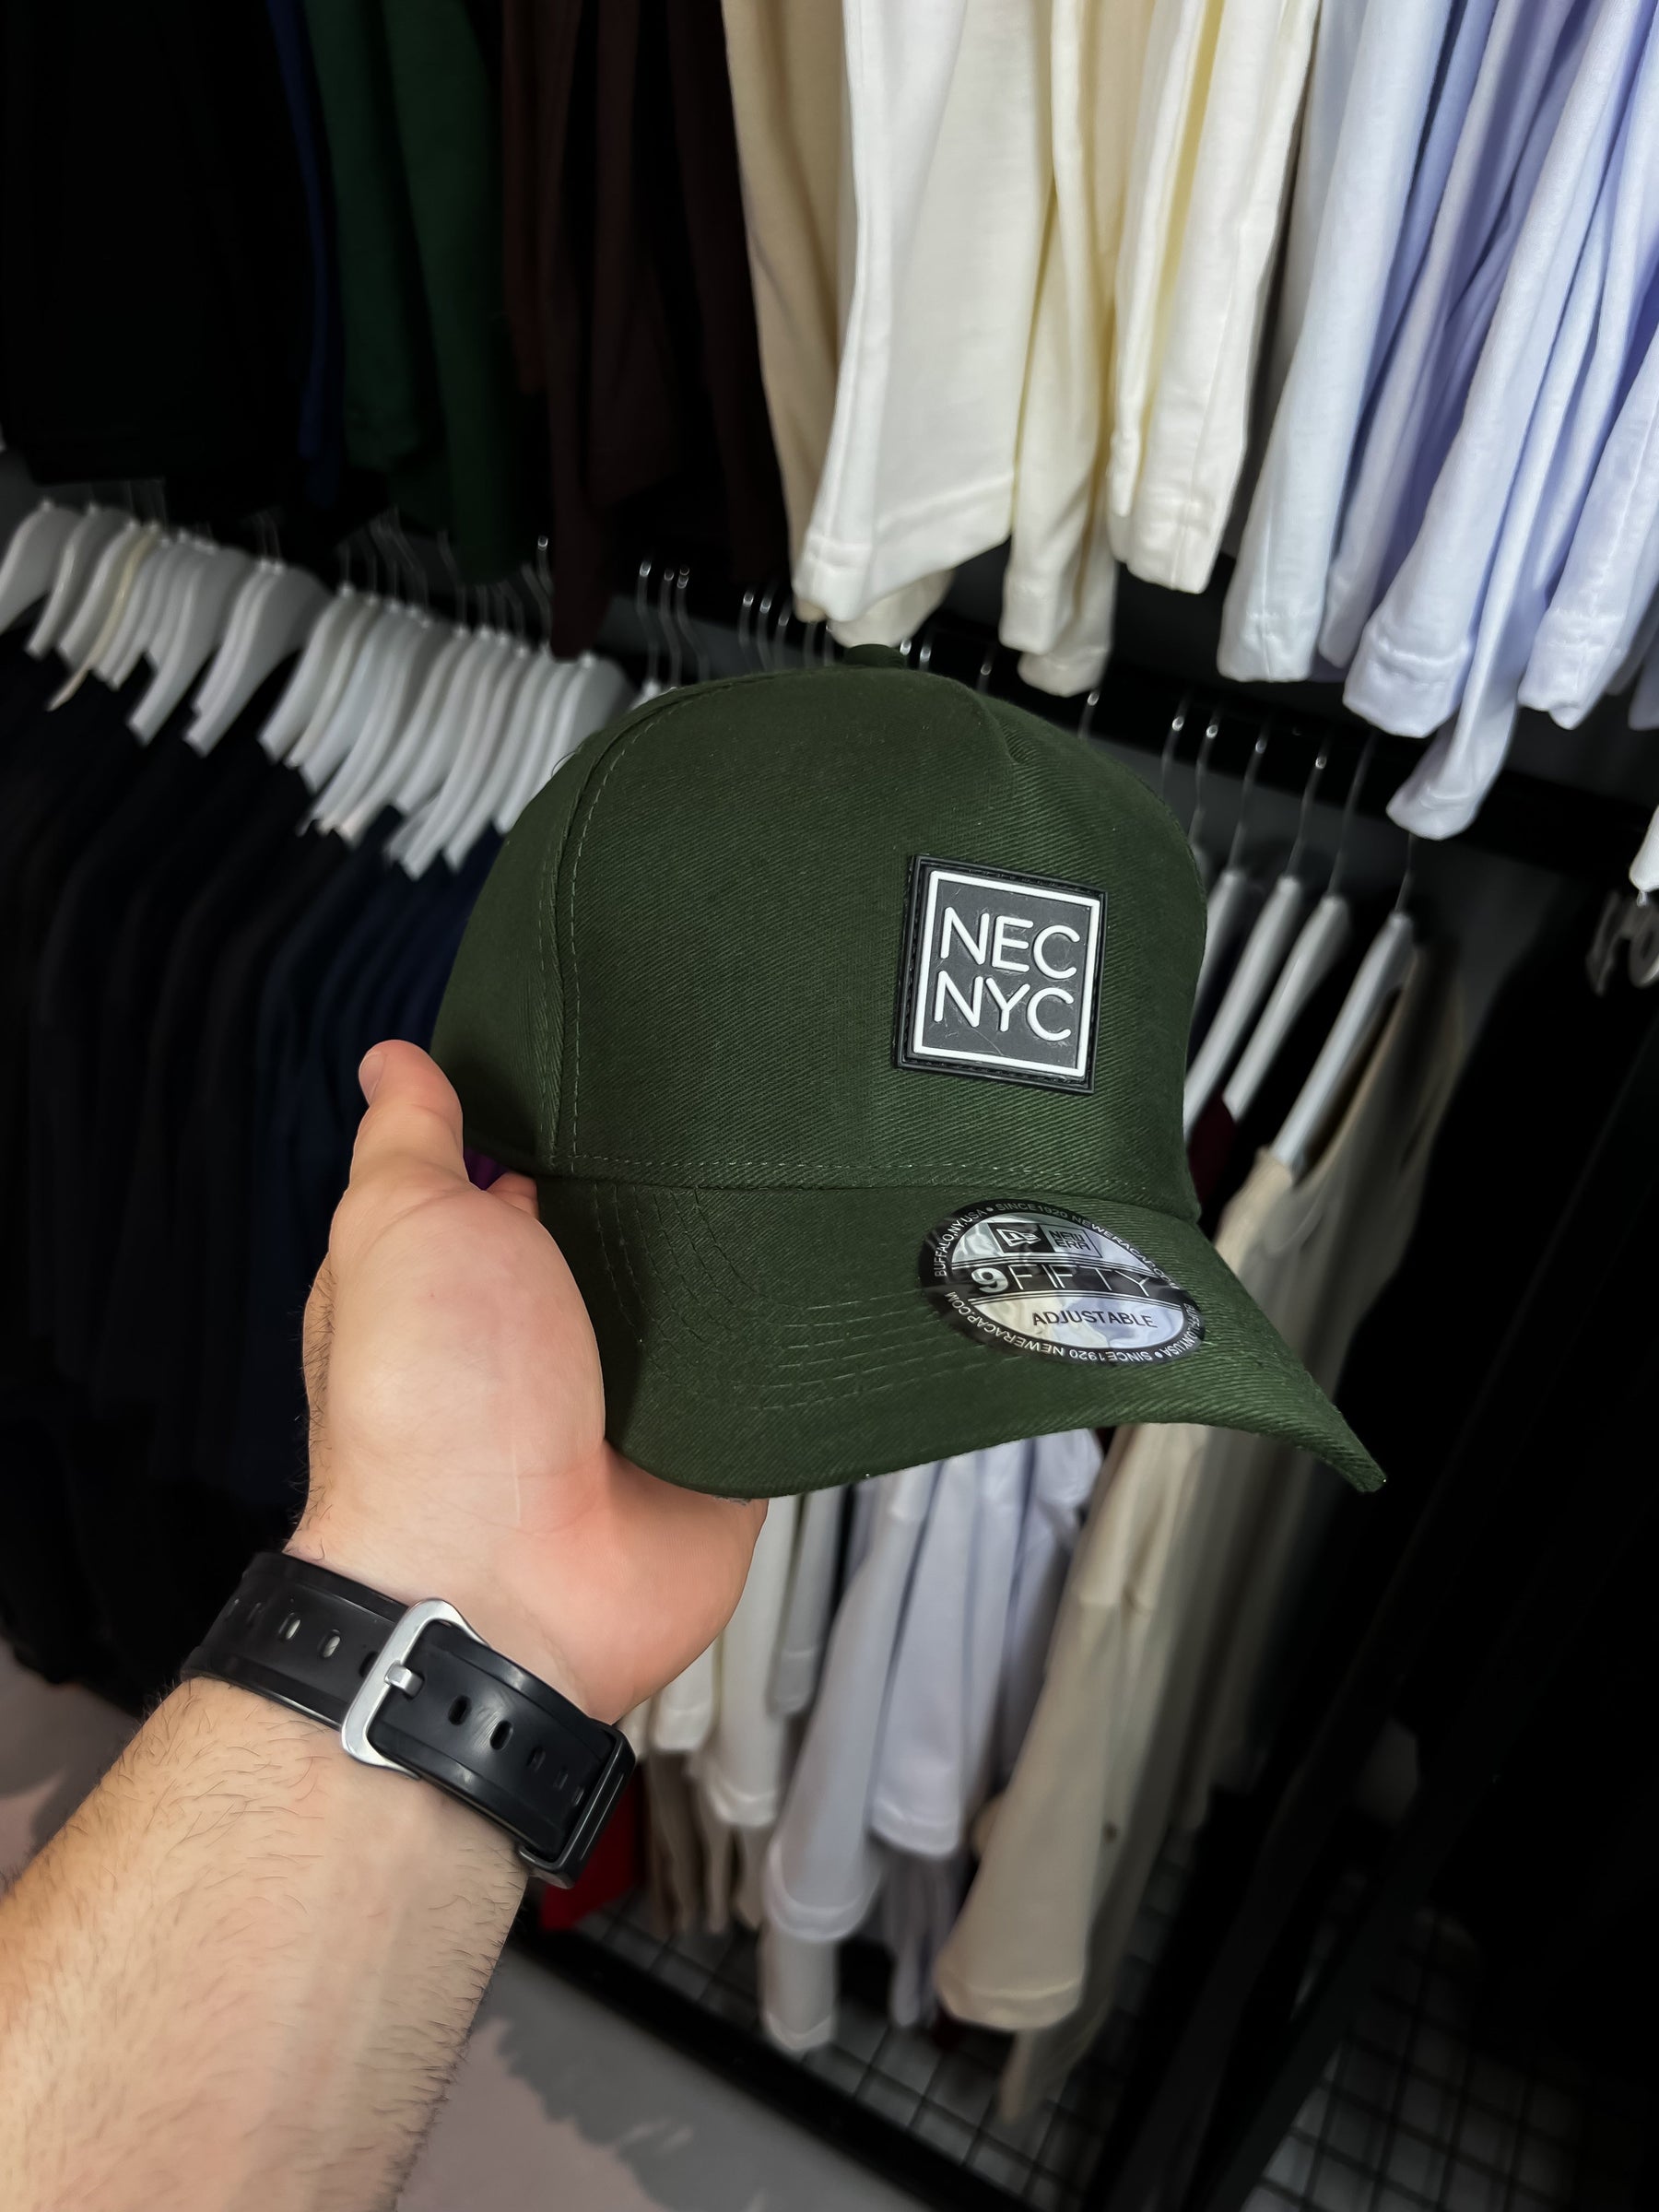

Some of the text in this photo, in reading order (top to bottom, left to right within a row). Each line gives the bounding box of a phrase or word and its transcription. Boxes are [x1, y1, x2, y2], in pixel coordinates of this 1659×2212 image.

[939, 906, 1081, 980] NEC
[934, 970, 1075, 1041] NYC
[1049, 1230, 1086, 1242] NEW
[1054, 1239, 1091, 1251] ERA
[971, 1264, 1150, 1298] 9FIFTY
[1032, 1310, 1159, 1328] ADJUSTABLE
